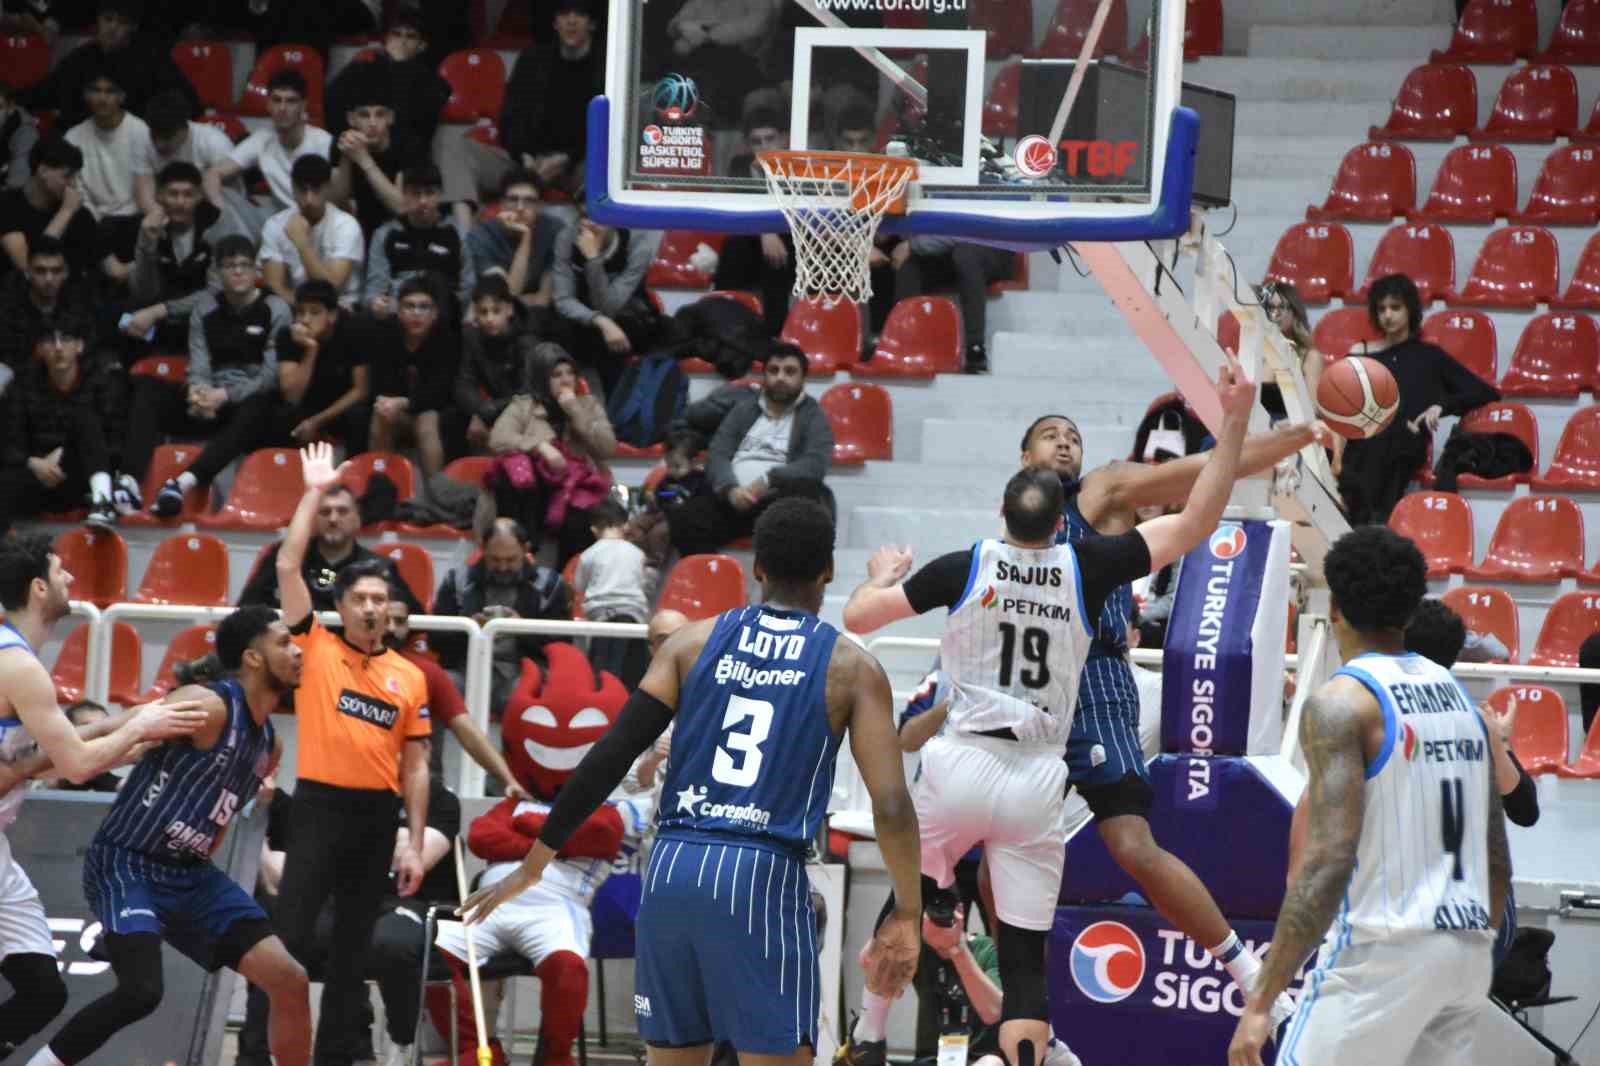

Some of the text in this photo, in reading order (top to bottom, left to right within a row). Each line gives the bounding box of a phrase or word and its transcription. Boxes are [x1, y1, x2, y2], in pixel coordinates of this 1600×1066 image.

[640, 145, 705, 157] BASKETBOL
[1060, 140, 1137, 176] TBF
[1469, 147, 1491, 160] 14
[1305, 226, 1329, 239] 15
[1407, 226, 1430, 240] 14
[1511, 231, 1535, 244] 13
[921, 302, 932, 315] 1
[1450, 316, 1474, 331] 13
[1551, 316, 1576, 331] 12
[850, 387, 862, 401] 1
[1490, 408, 1514, 422] 12
[1424, 496, 1448, 511] 12
[1534, 499, 1558, 512] 11
[707, 559, 719, 574] 1
[995, 560, 1063, 588] SAJUS
[1467, 592, 1491, 608] 11
[415, 639, 428, 653] 3
[738, 625, 806, 660] LOYD
[998, 621, 1051, 690] 19
[715, 654, 806, 689] Bilyoner
[1516, 688, 1543, 702] 10
[712, 693, 775, 787] 3
[208, 788, 239, 826] 15
[700, 802, 771, 825] corendon
[1440, 776, 1465, 881] 4
